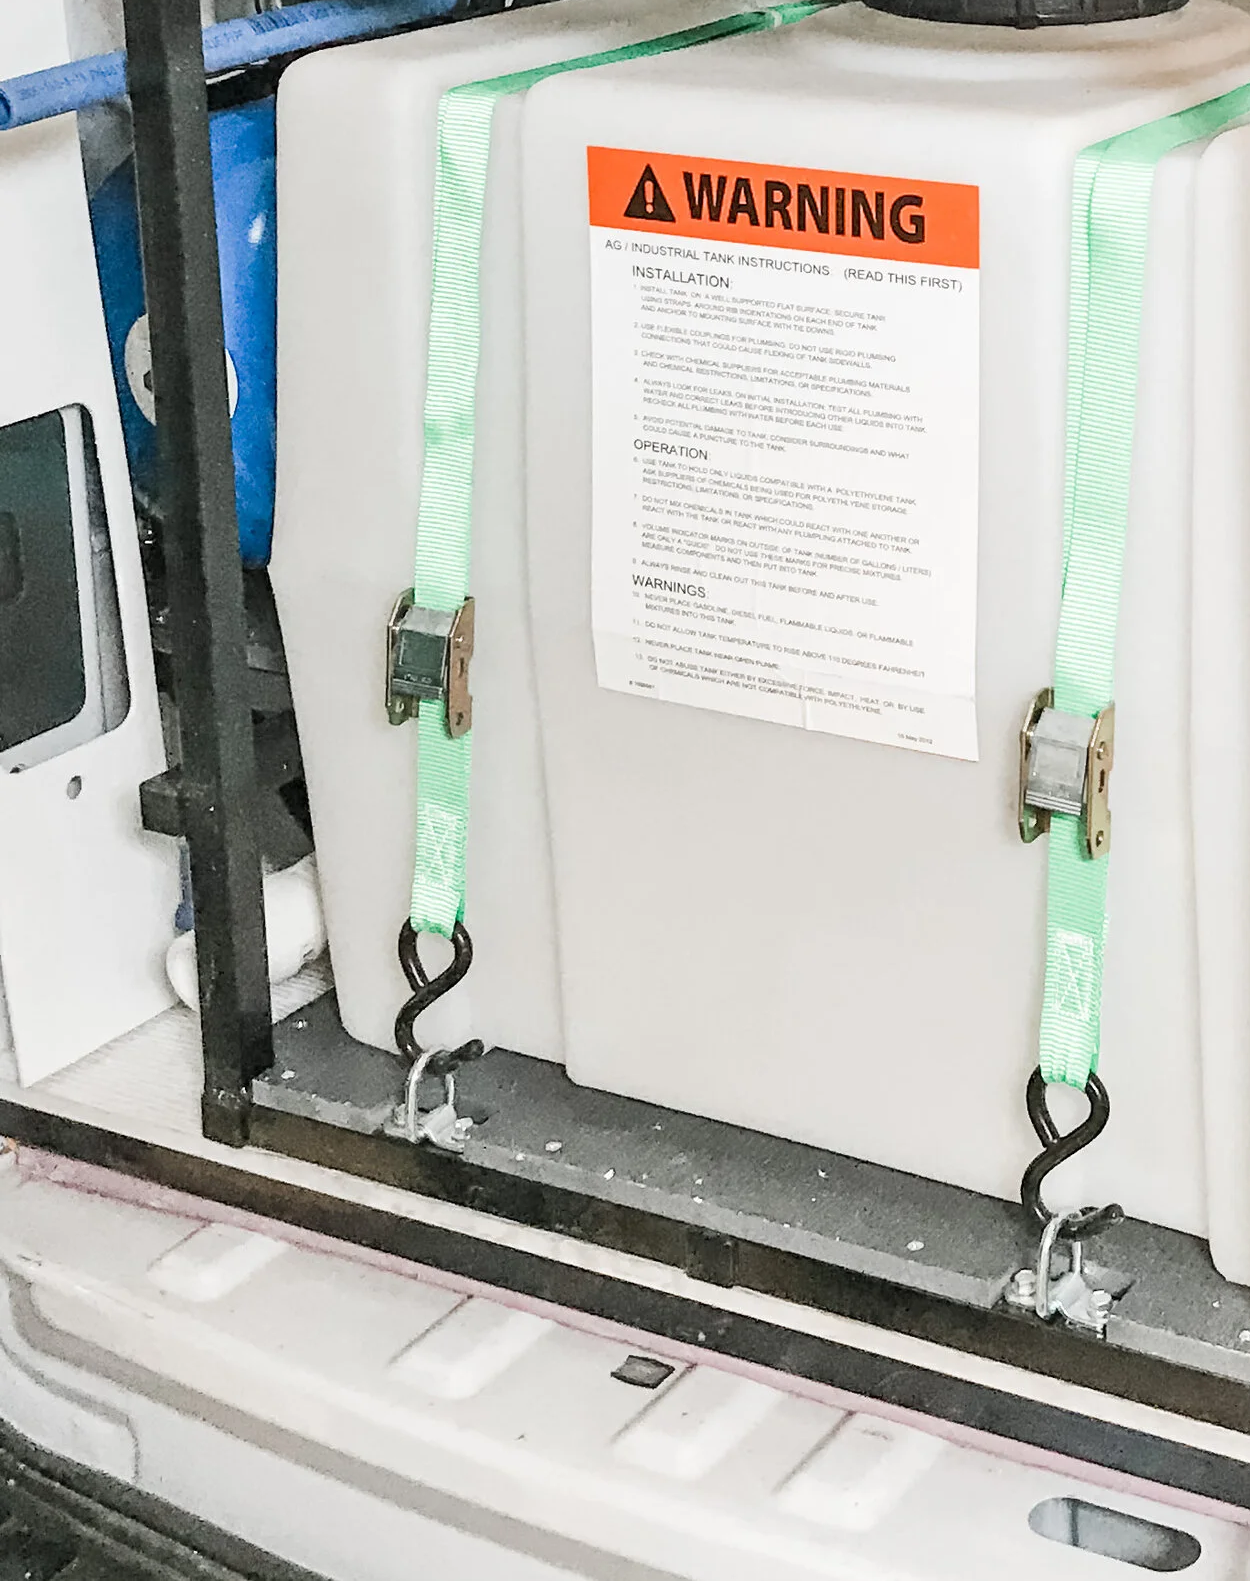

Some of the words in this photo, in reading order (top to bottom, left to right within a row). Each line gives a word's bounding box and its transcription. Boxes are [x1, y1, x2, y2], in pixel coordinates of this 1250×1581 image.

[682, 171, 926, 244] WARNING
[605, 239, 622, 250] AG
[631, 242, 700, 260] INDUSTRIAL
[703, 251, 734, 264] TANK
[843, 268, 883, 282] (READ
[887, 272, 916, 285] THIS
[920, 276, 962, 292] FIRST)
